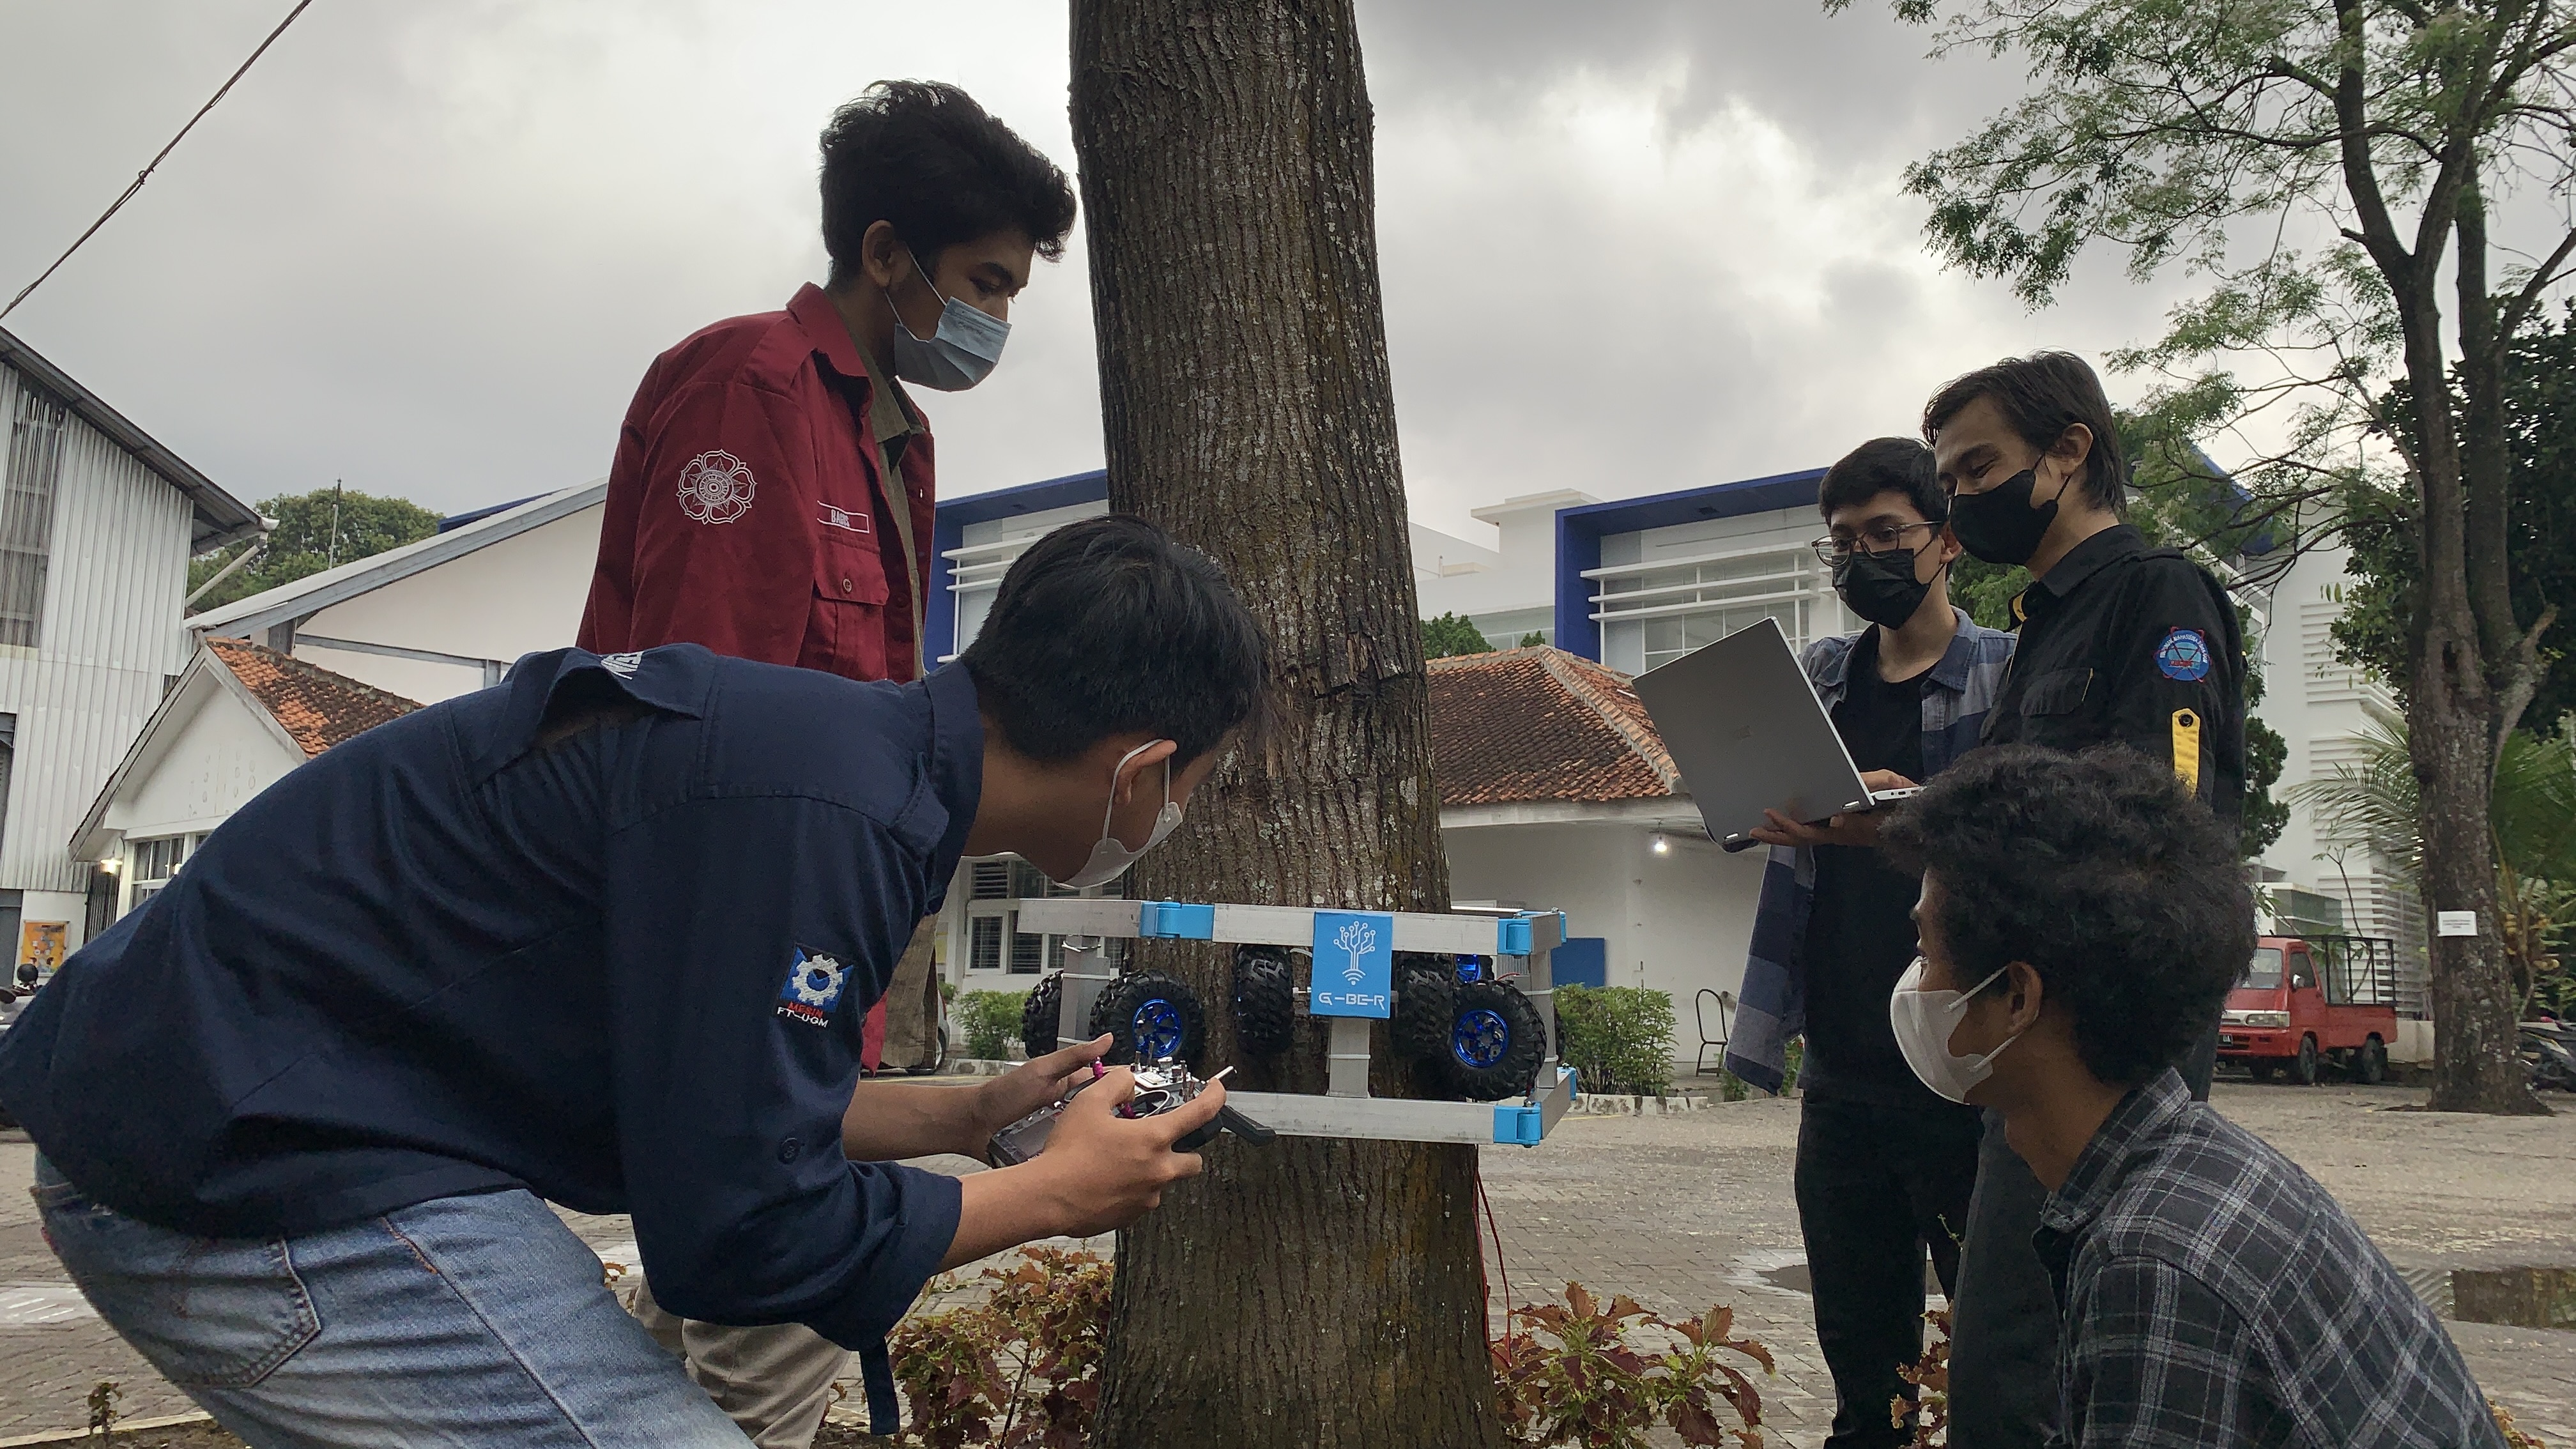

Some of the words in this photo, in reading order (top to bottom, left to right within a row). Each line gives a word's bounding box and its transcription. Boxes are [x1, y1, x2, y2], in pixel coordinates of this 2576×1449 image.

[788, 1001, 824, 1019] MESIN
[1319, 992, 1385, 1011] G-BER
[777, 1006, 829, 1028] FT-UGM
